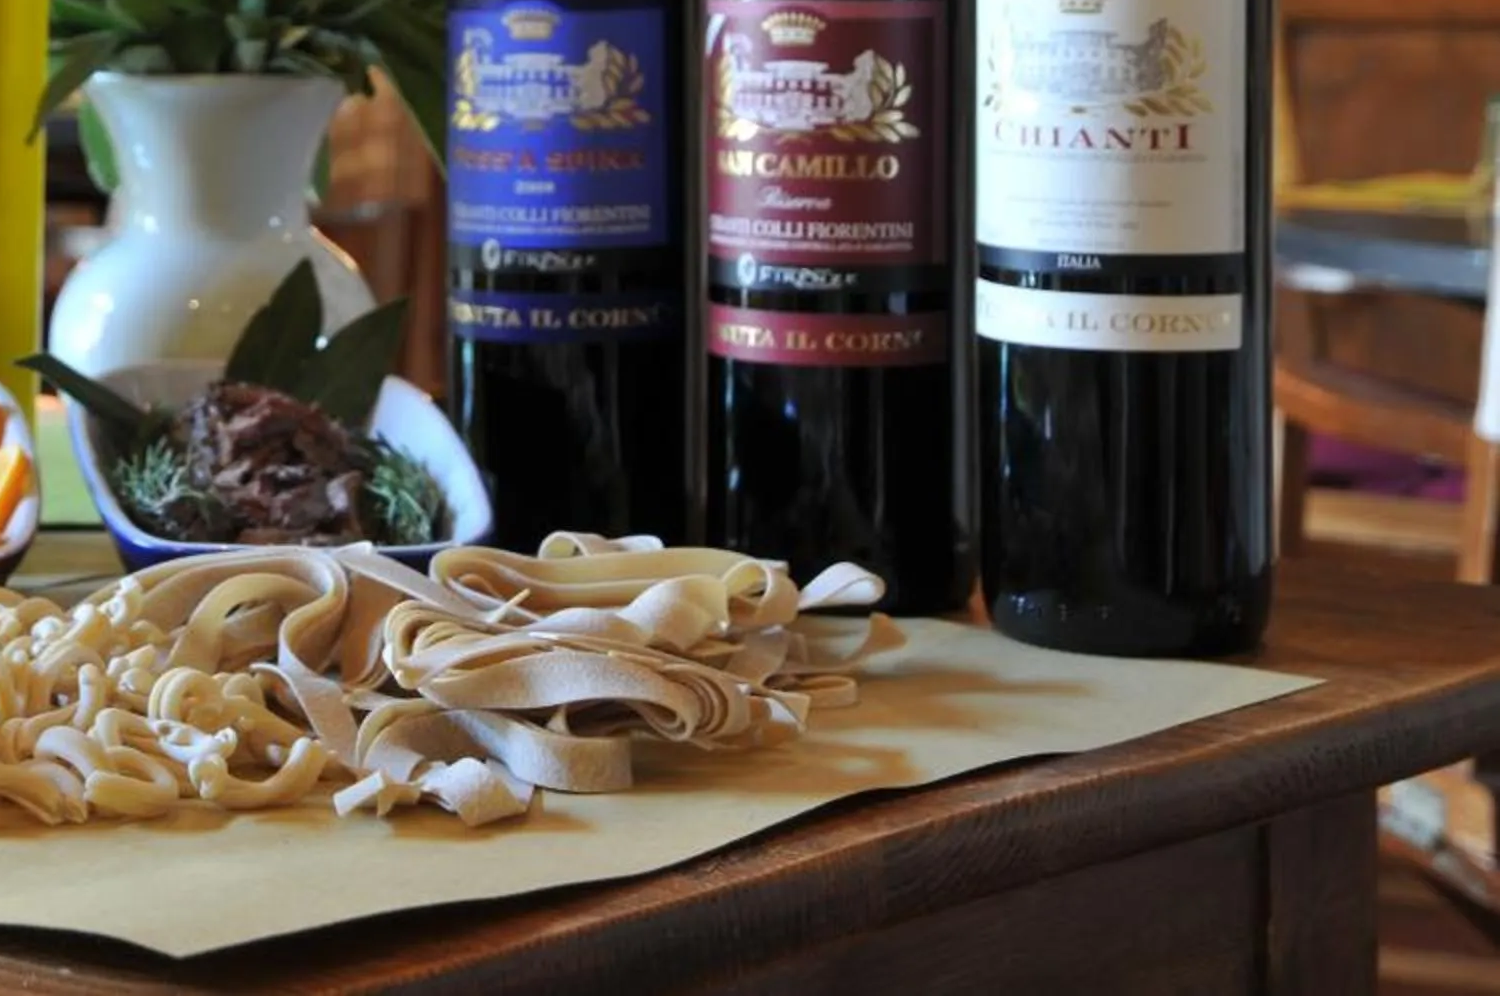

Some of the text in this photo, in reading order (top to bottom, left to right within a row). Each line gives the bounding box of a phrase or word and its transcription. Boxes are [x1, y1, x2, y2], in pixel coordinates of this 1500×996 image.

[994, 120, 1194, 151] CHIANTI
[755, 154, 901, 180] CAMILLO
[752, 219, 803, 238] COLLI
[808, 221, 914, 240] FIORENTINI
[1057, 254, 1101, 269] ITALIA
[1066, 310, 1100, 332] IL
[785, 331, 818, 350] IL
